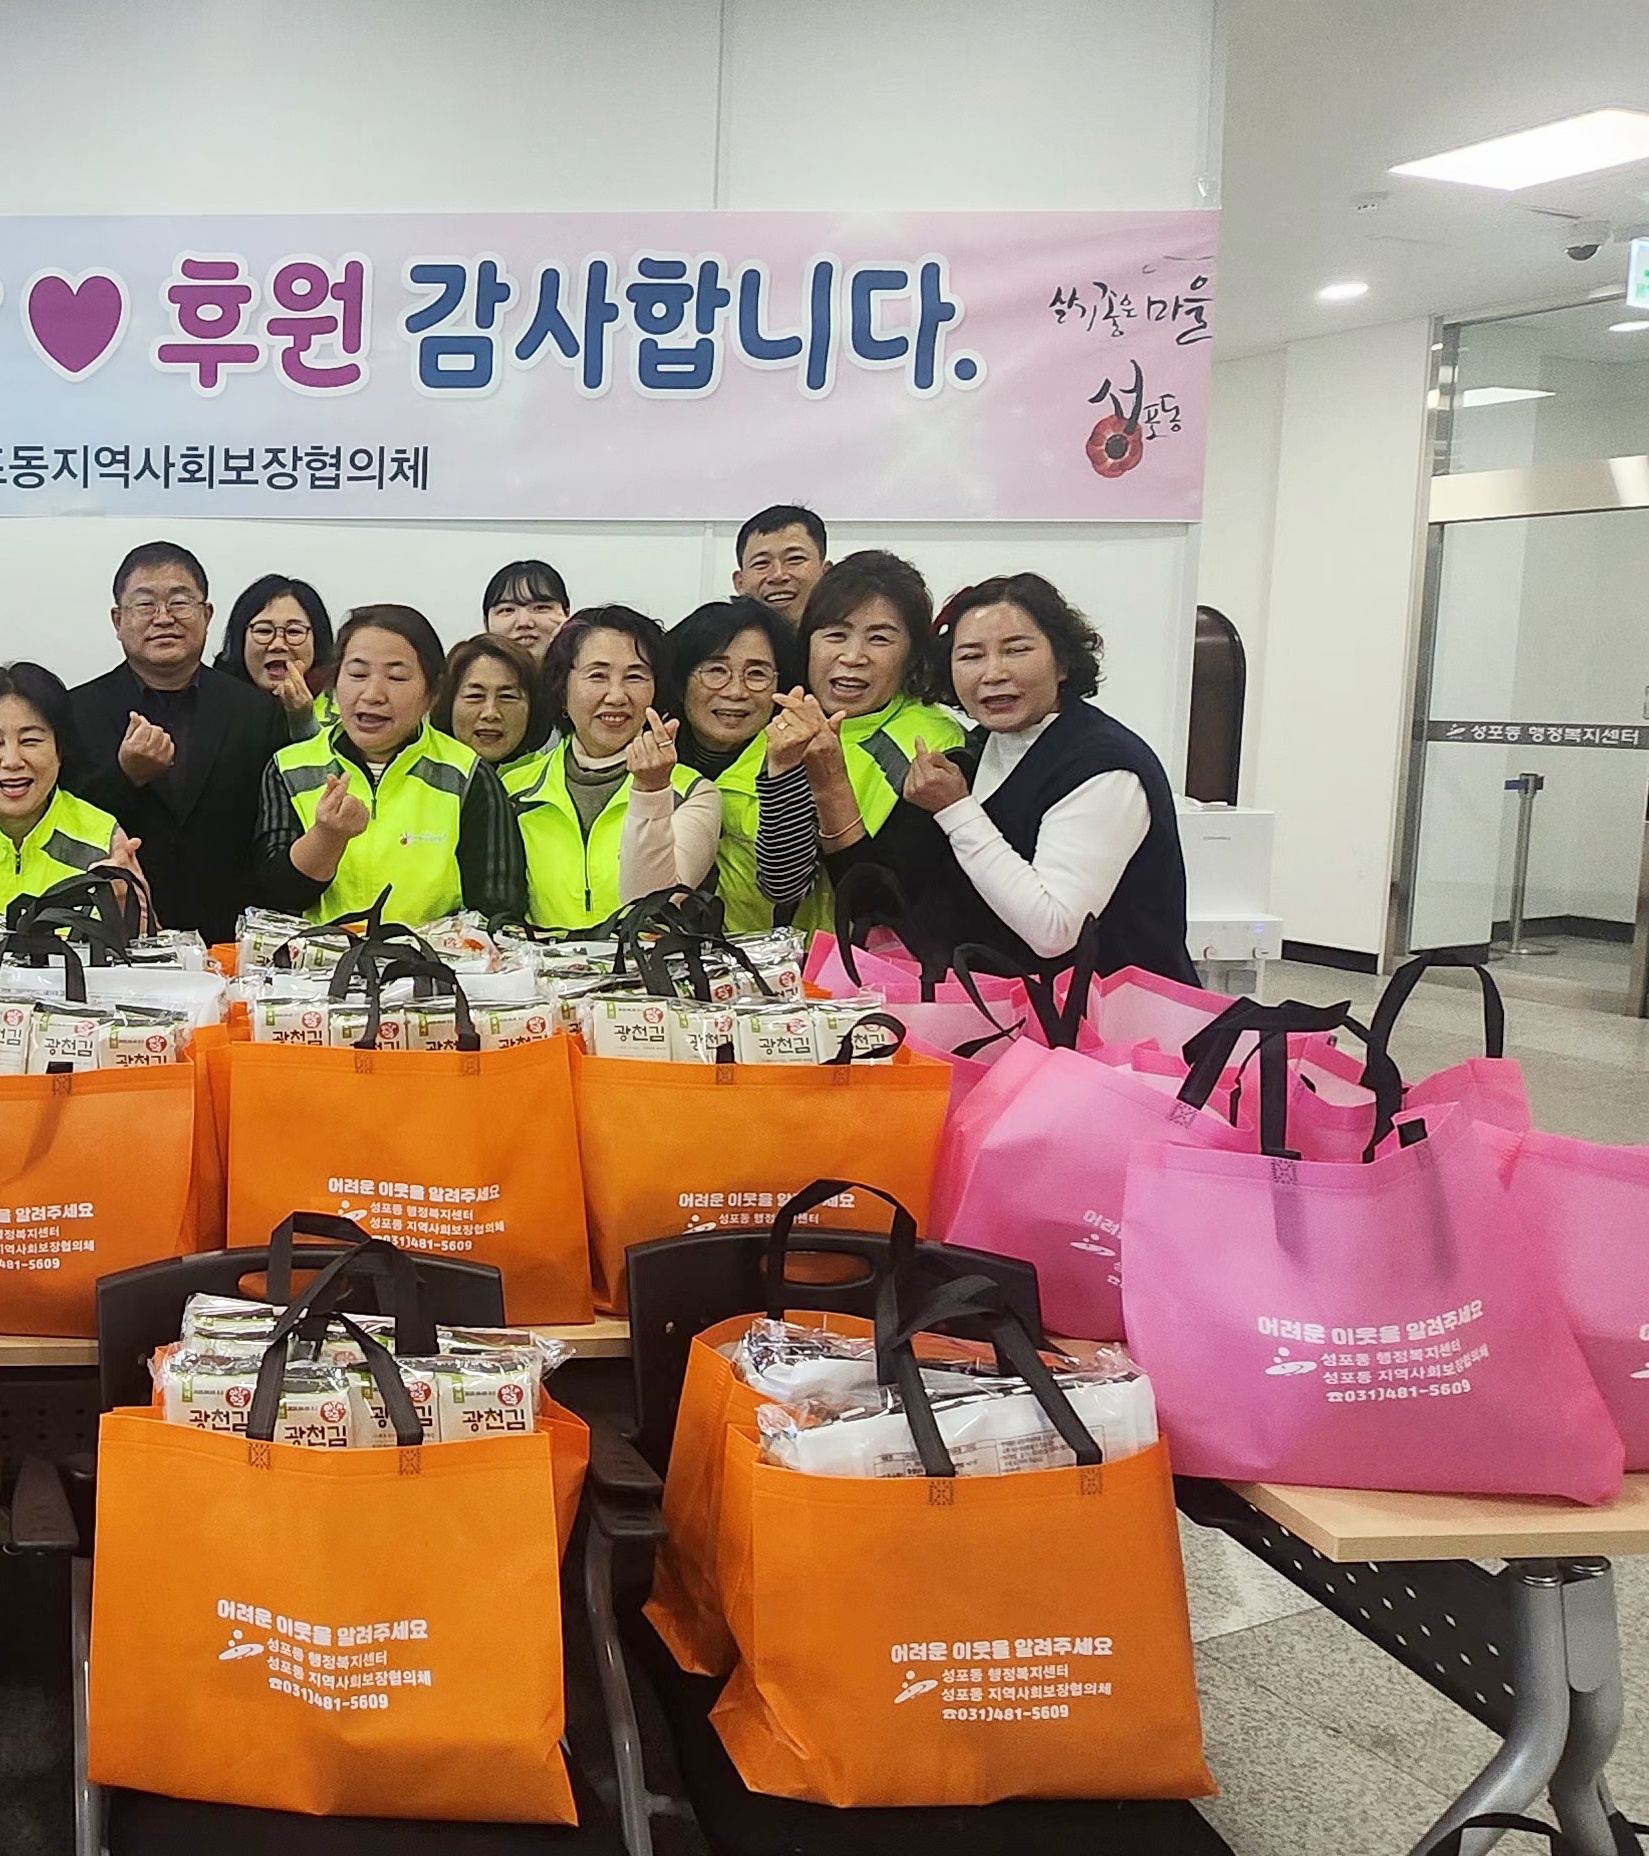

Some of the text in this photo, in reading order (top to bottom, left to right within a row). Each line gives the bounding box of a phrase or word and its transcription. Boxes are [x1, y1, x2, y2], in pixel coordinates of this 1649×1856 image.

[158, 258, 364, 390] 후원
[405, 256, 977, 392] 감사합니다.
[1470, 724, 1639, 746] 성포동 행정복지센터
[614, 1024, 665, 1042] 광천김
[44, 1036, 94, 1058] 광천김
[759, 1036, 811, 1055] 광천김
[328, 1177, 501, 1203] 어려운 이웃을 알려주세요
[678, 1192, 724, 1208] 어려운
[728, 1192, 773, 1207] 이웃을
[15, 1202, 94, 1223] 알려주세요
[370, 1202, 474, 1221] 성포동 행정복지센터
[718, 1213, 750, 1225] 성포동
[369, 1217, 505, 1236] 성포동 지역사회보장협의체
[1257, 1299, 1483, 1345] 어려운 이웃을 알려주세요
[1320, 1338, 1461, 1367] 성포동 행정복지센터
[1322, 1343, 1490, 1385] 성포동 지역사회보장협의체
[1344, 1379, 1472, 1402] 031)481-5609
[462, 1407, 525, 1432] 광천김
[284, 1424, 348, 1448] 광천김
[217, 1599, 428, 1647] 어려운 이웃을 알려주세요
[266, 1637, 387, 1670] 성포동 행정복지센터
[891, 1636, 1113, 1663] 어려운 이웃을 알려주세요
[267, 1655, 432, 1690] 성포동 지역사회보장협의체
[941, 1664, 1069, 1683] 성포동 행정복지센터
[283, 1681, 388, 1711] 031)481-5609
[941, 1682, 1112, 1702] 성포동 지역사회보장협의체
[957, 1705, 1069, 1721] 031)481-5609
